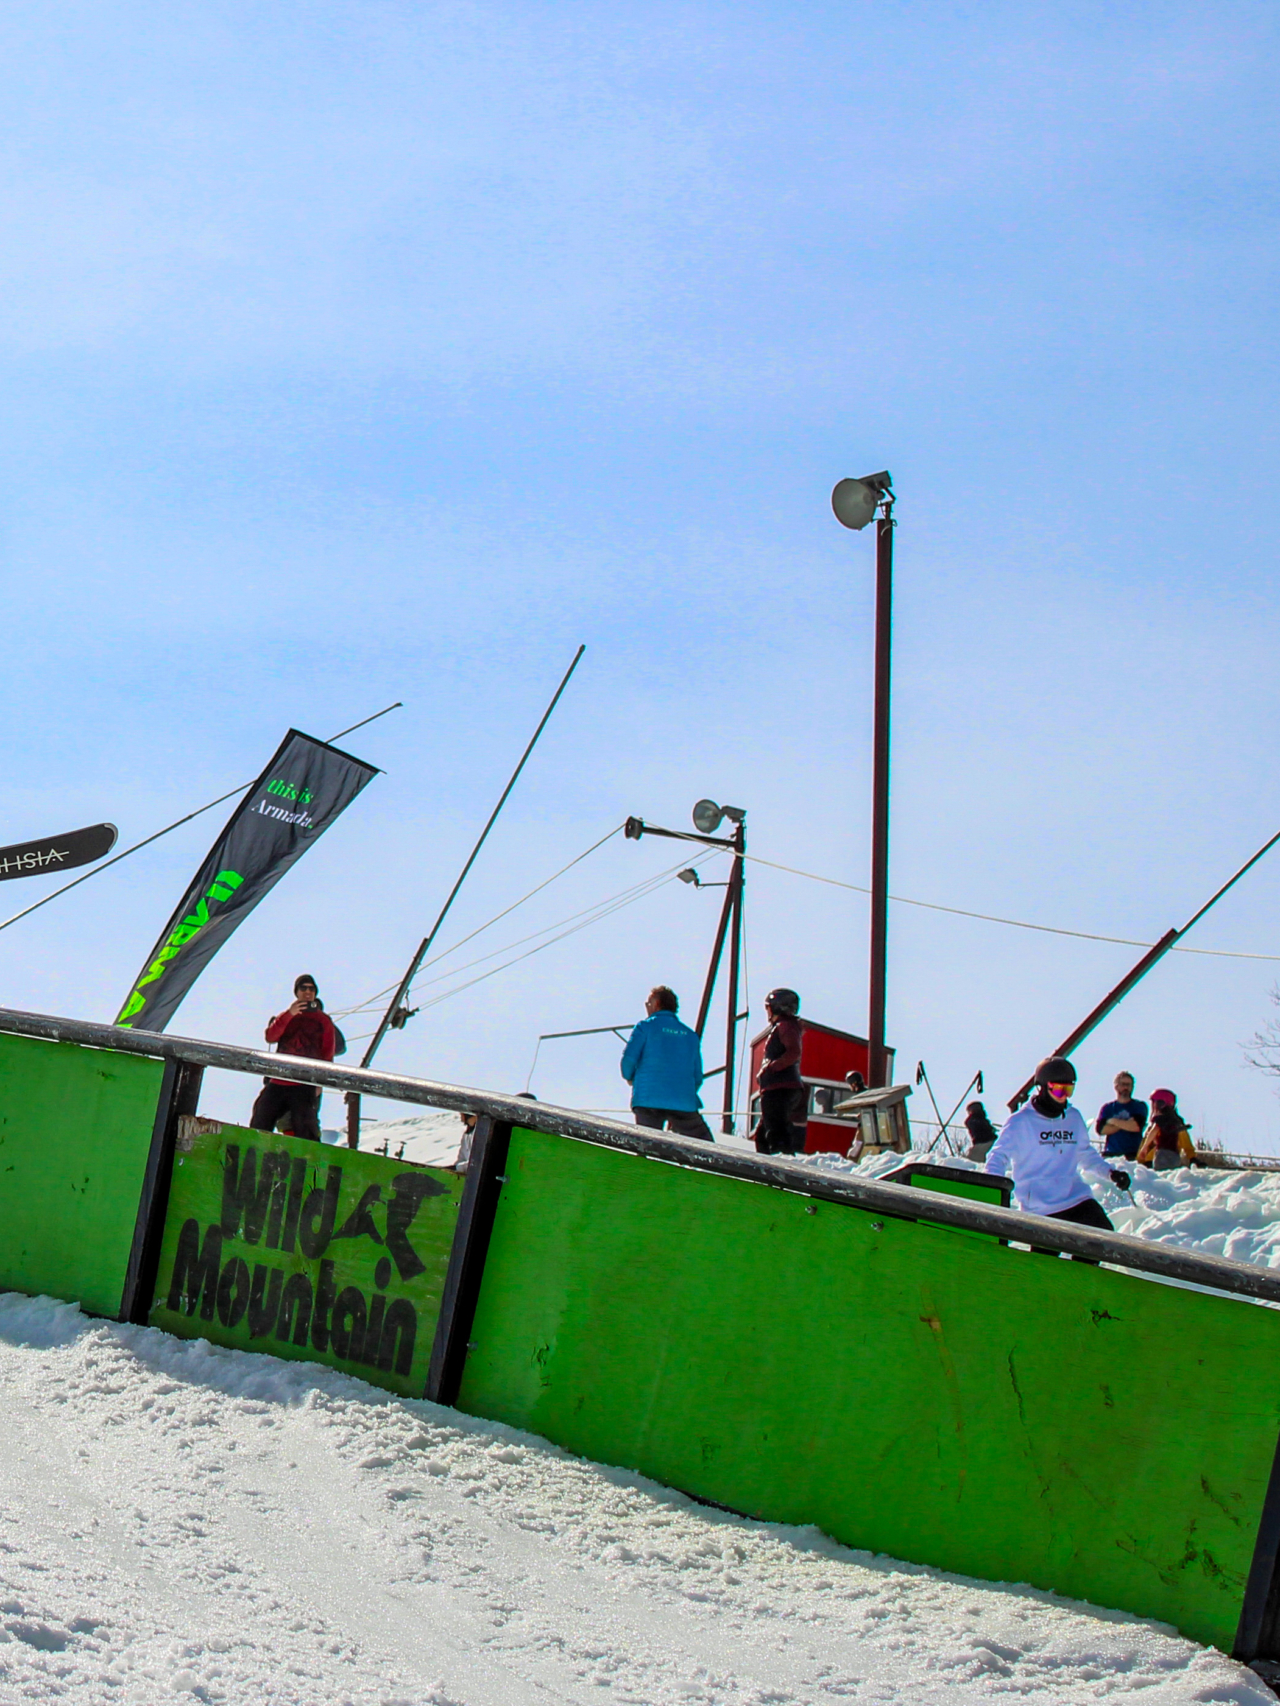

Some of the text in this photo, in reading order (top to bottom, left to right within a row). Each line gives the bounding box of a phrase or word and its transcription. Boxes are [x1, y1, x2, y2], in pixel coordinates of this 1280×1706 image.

[267, 779, 314, 804] this is
[220, 1143, 343, 1260] Wild
[166, 1217, 417, 1377] Mountain
